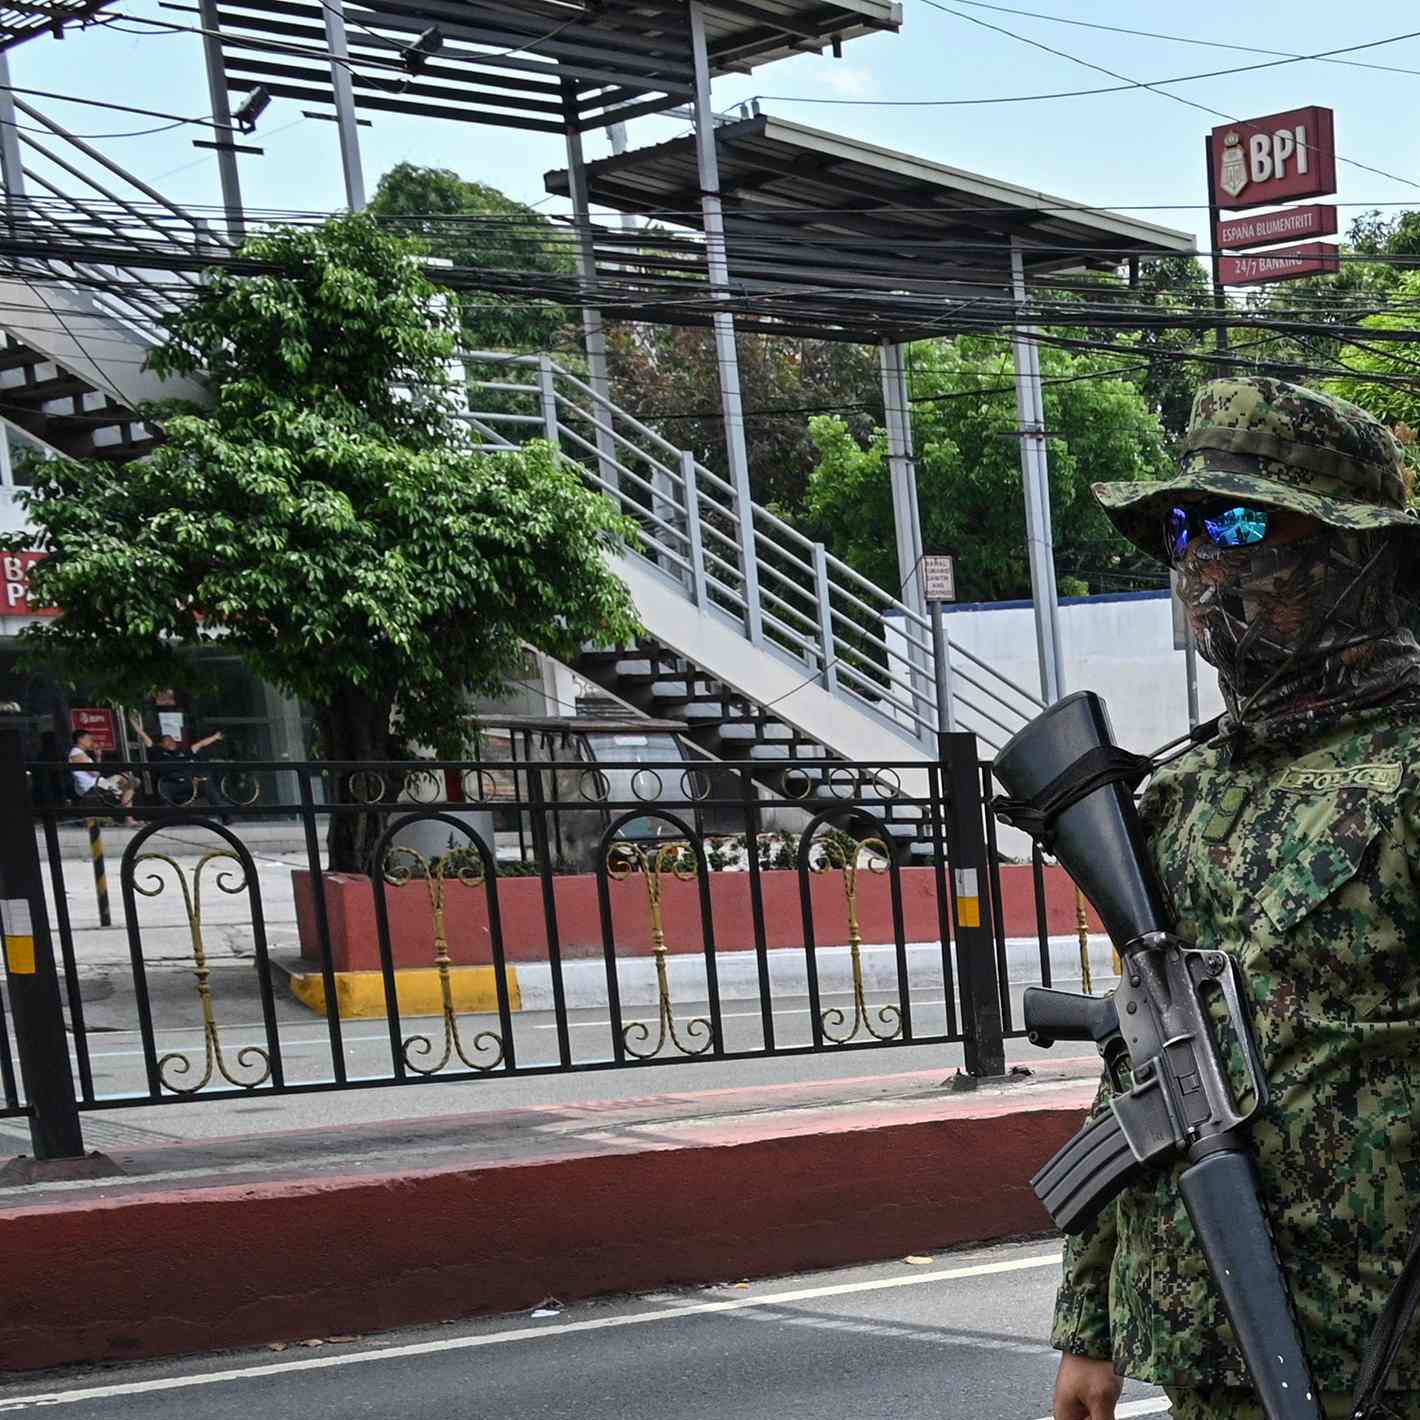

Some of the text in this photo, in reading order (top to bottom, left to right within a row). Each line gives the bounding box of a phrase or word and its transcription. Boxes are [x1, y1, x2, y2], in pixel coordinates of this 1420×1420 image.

[1250, 126, 1308, 183] BPI
[1256, 213, 1313, 237] BLUMENTRITT
[1234, 257, 1257, 276] 24/7
